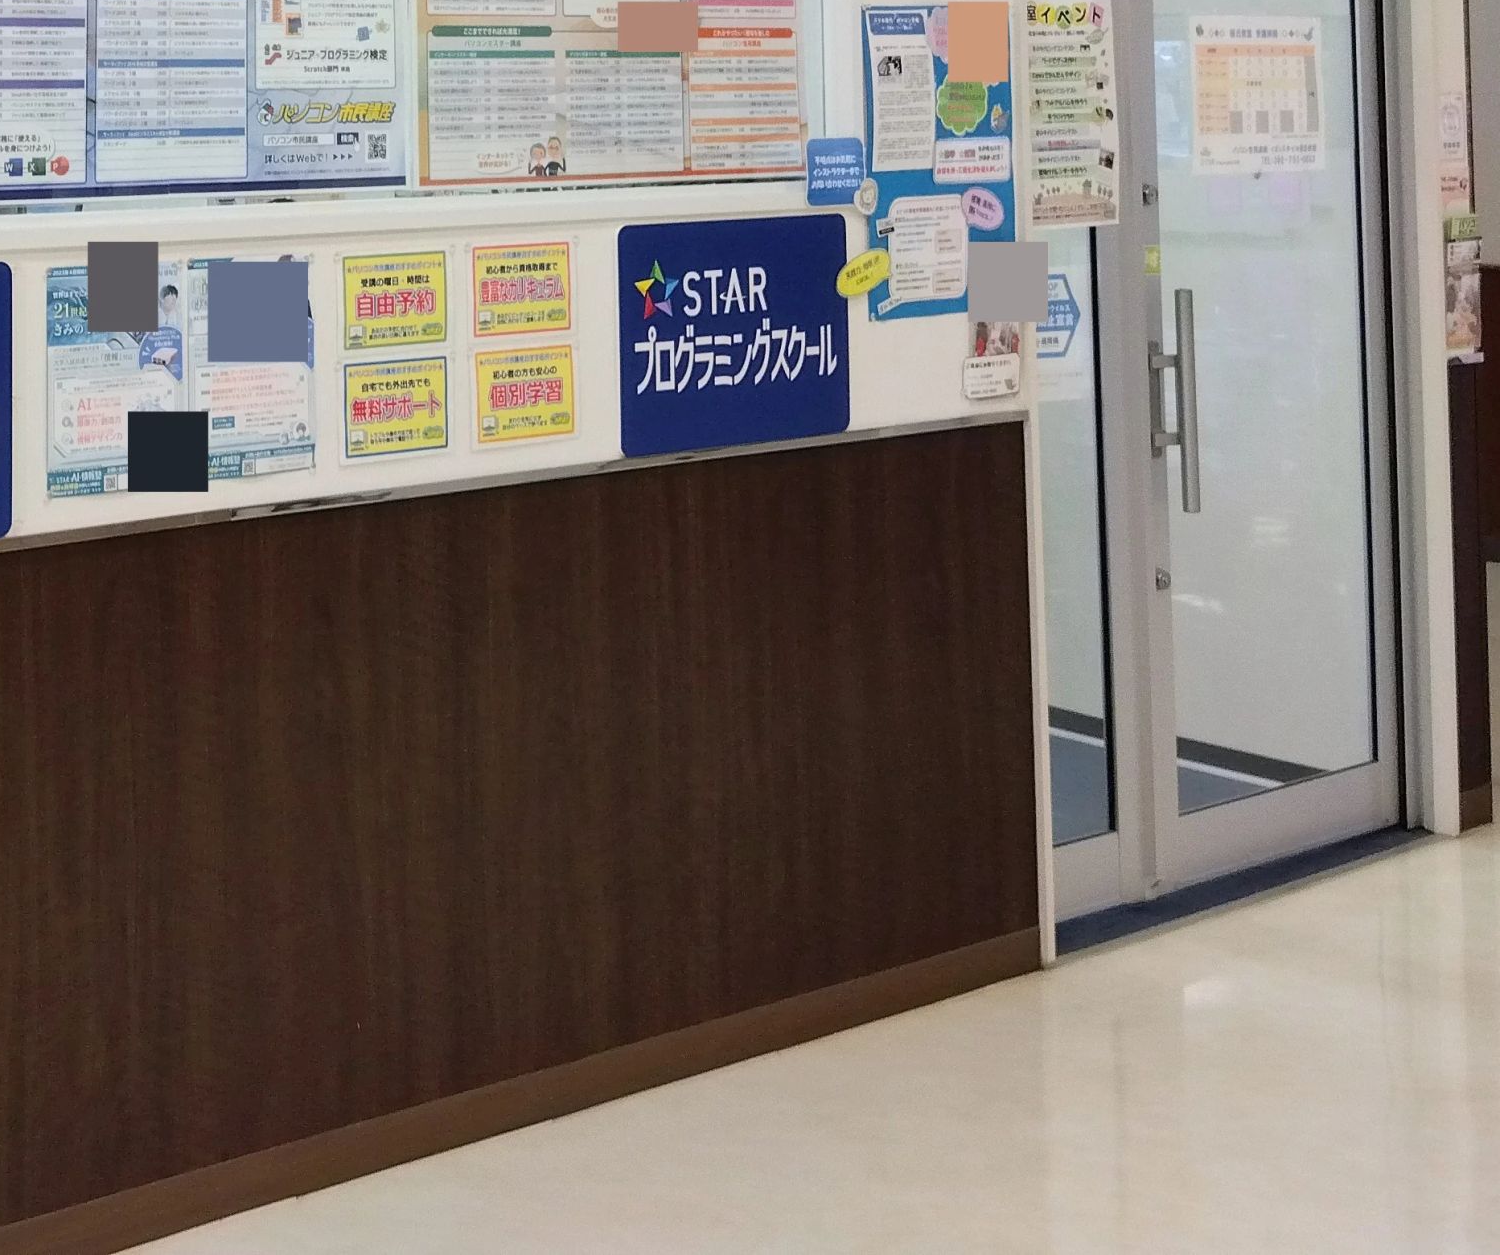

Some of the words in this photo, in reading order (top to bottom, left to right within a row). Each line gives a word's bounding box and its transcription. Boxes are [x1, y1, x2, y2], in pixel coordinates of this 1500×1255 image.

[273, 100, 396, 124] パソコン市民講座
[486, 262, 558, 275] 初心者から資格取得まで
[356, 289, 436, 320] 自由予約
[479, 274, 565, 305] 豊富なカリキュラム
[682, 267, 768, 317] STAR
[634, 317, 838, 395] プログラミングスクール
[361, 379, 431, 393] 自宅でも外出先でも
[493, 366, 557, 380] 初心者の方も安心の
[77, 398, 92, 411] AI
[351, 392, 442, 425] 無料サポート
[489, 379, 563, 411] 個別学習
